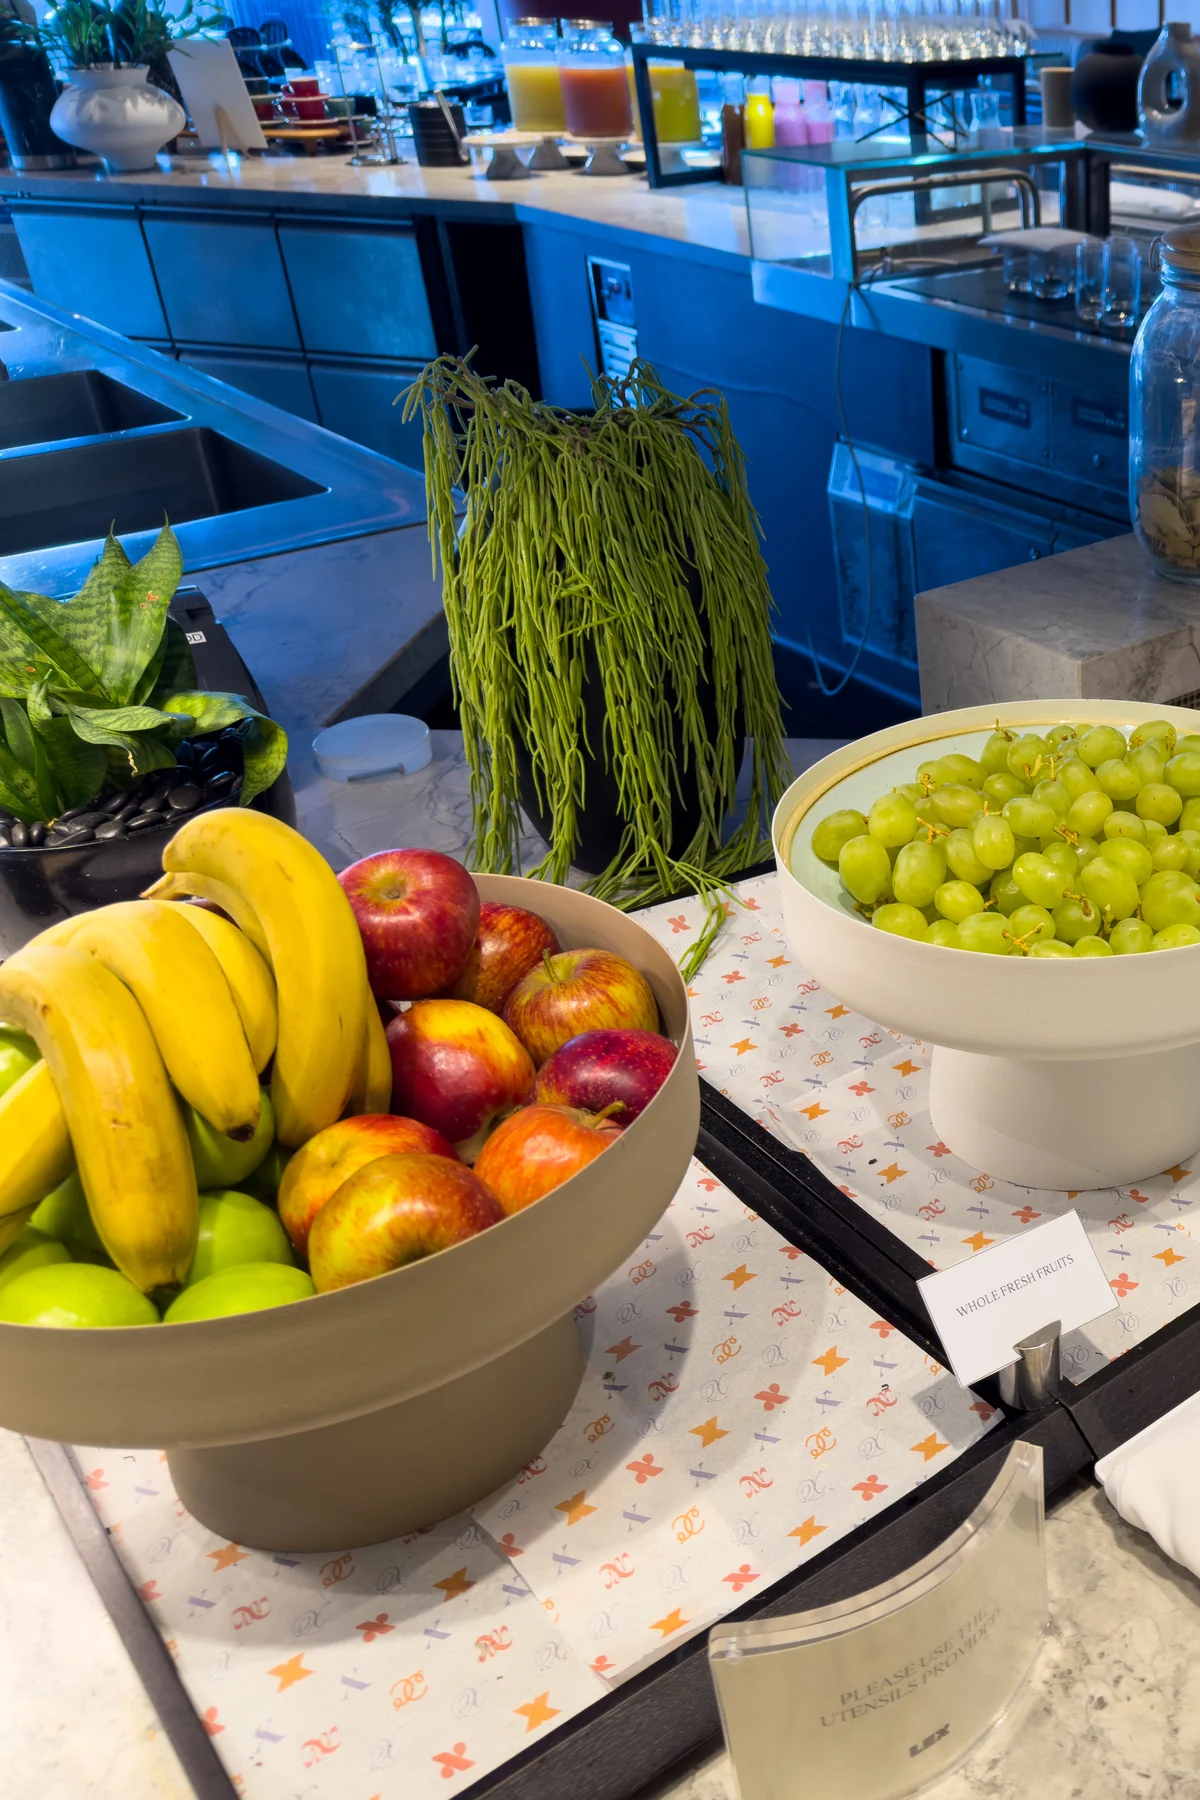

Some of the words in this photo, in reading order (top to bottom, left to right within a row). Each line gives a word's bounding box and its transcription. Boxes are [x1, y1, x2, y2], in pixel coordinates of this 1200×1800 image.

[956, 1290, 1000, 1317] WHOLE
[1000, 1272, 1036, 1297] FRESH
[1036, 1254, 1075, 1279] FRUITS
[820, 1679, 918, 1727] UTENSILS
[922, 1608, 1001, 1684] PROVIDED
[840, 1663, 916, 1705] PLEASE
[920, 1637, 955, 1668] USE
[958, 1606, 988, 1640] THE
